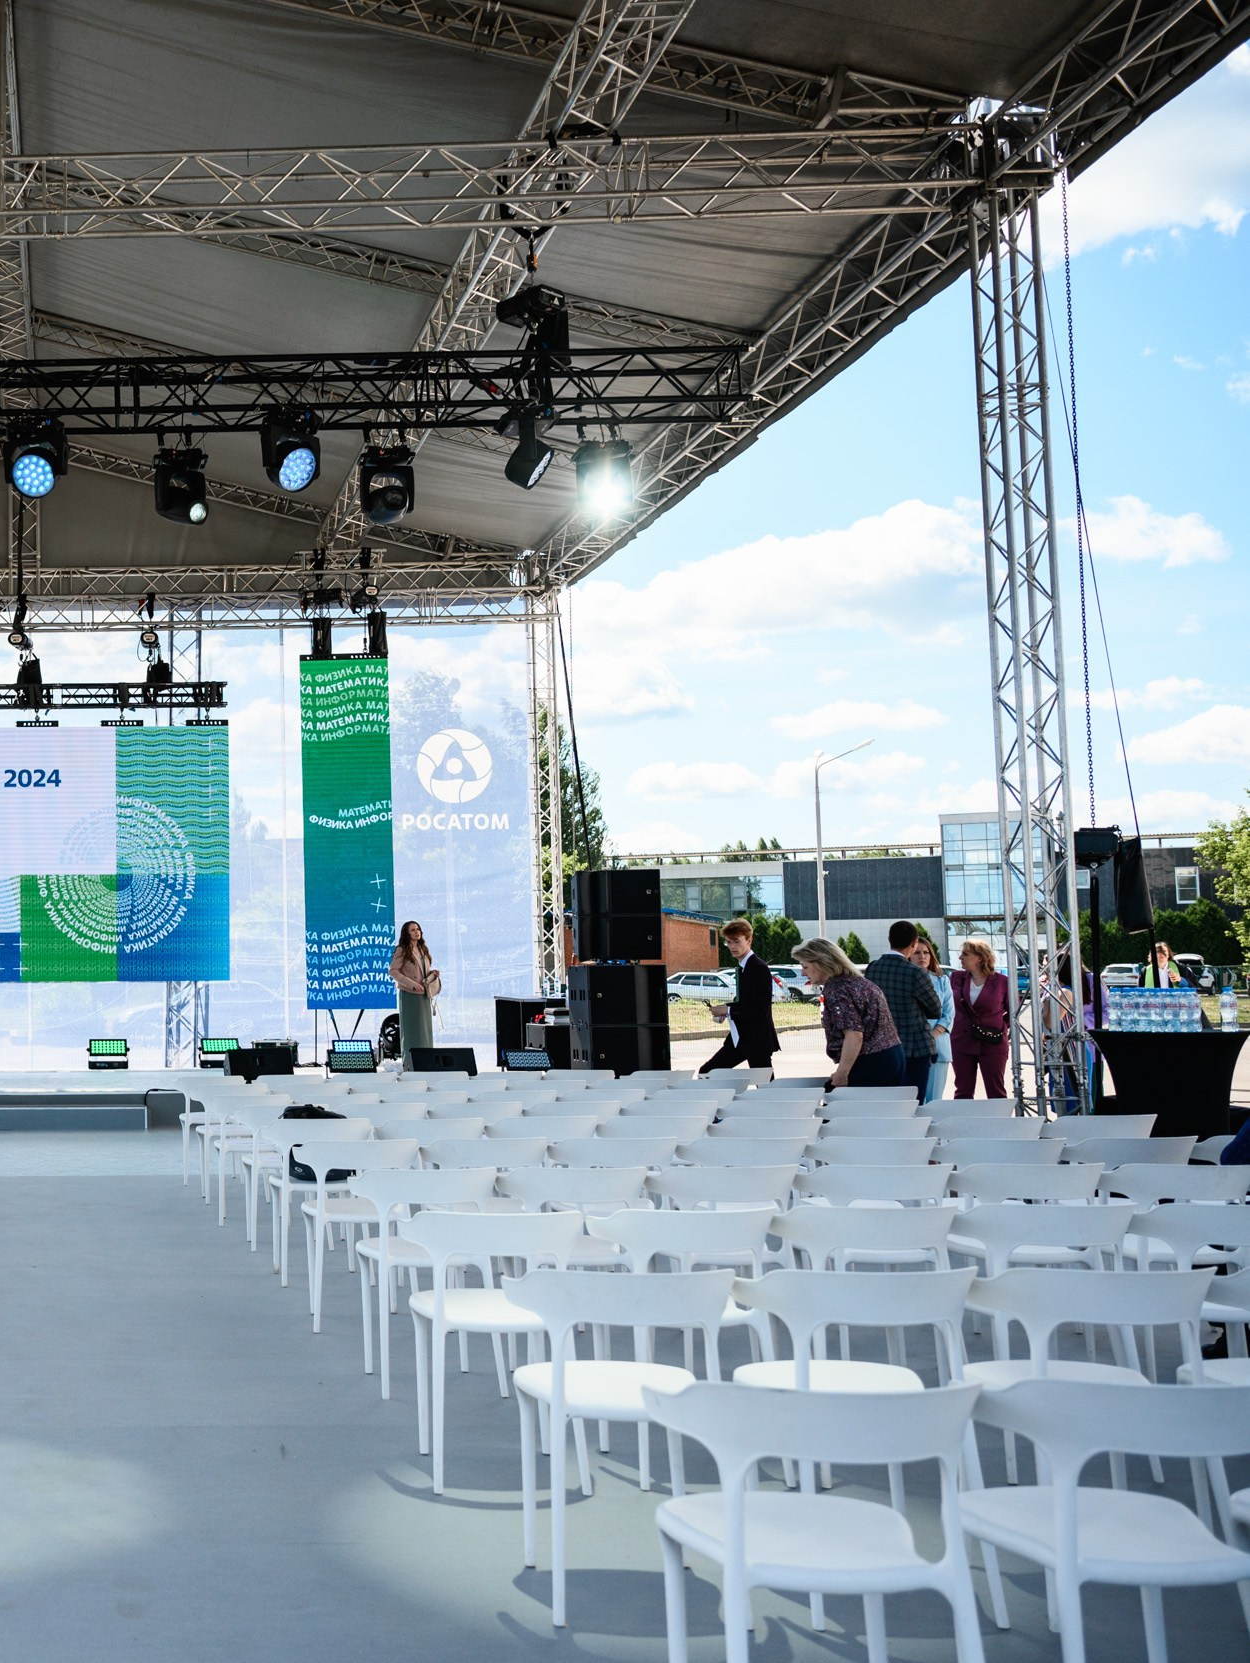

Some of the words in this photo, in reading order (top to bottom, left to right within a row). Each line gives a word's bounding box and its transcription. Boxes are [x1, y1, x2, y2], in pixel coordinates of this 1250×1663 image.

[315, 666, 362, 682] ФИЗИКА
[316, 702, 363, 718] ФИЗИКА
[4, 769, 62, 788] 2024
[309, 814, 354, 830] ФИЗИКА
[402, 813, 510, 830] РОСАТОМ
[321, 924, 368, 940] ФИЗИКА
[322, 961, 369, 977] ФИЗИКА
